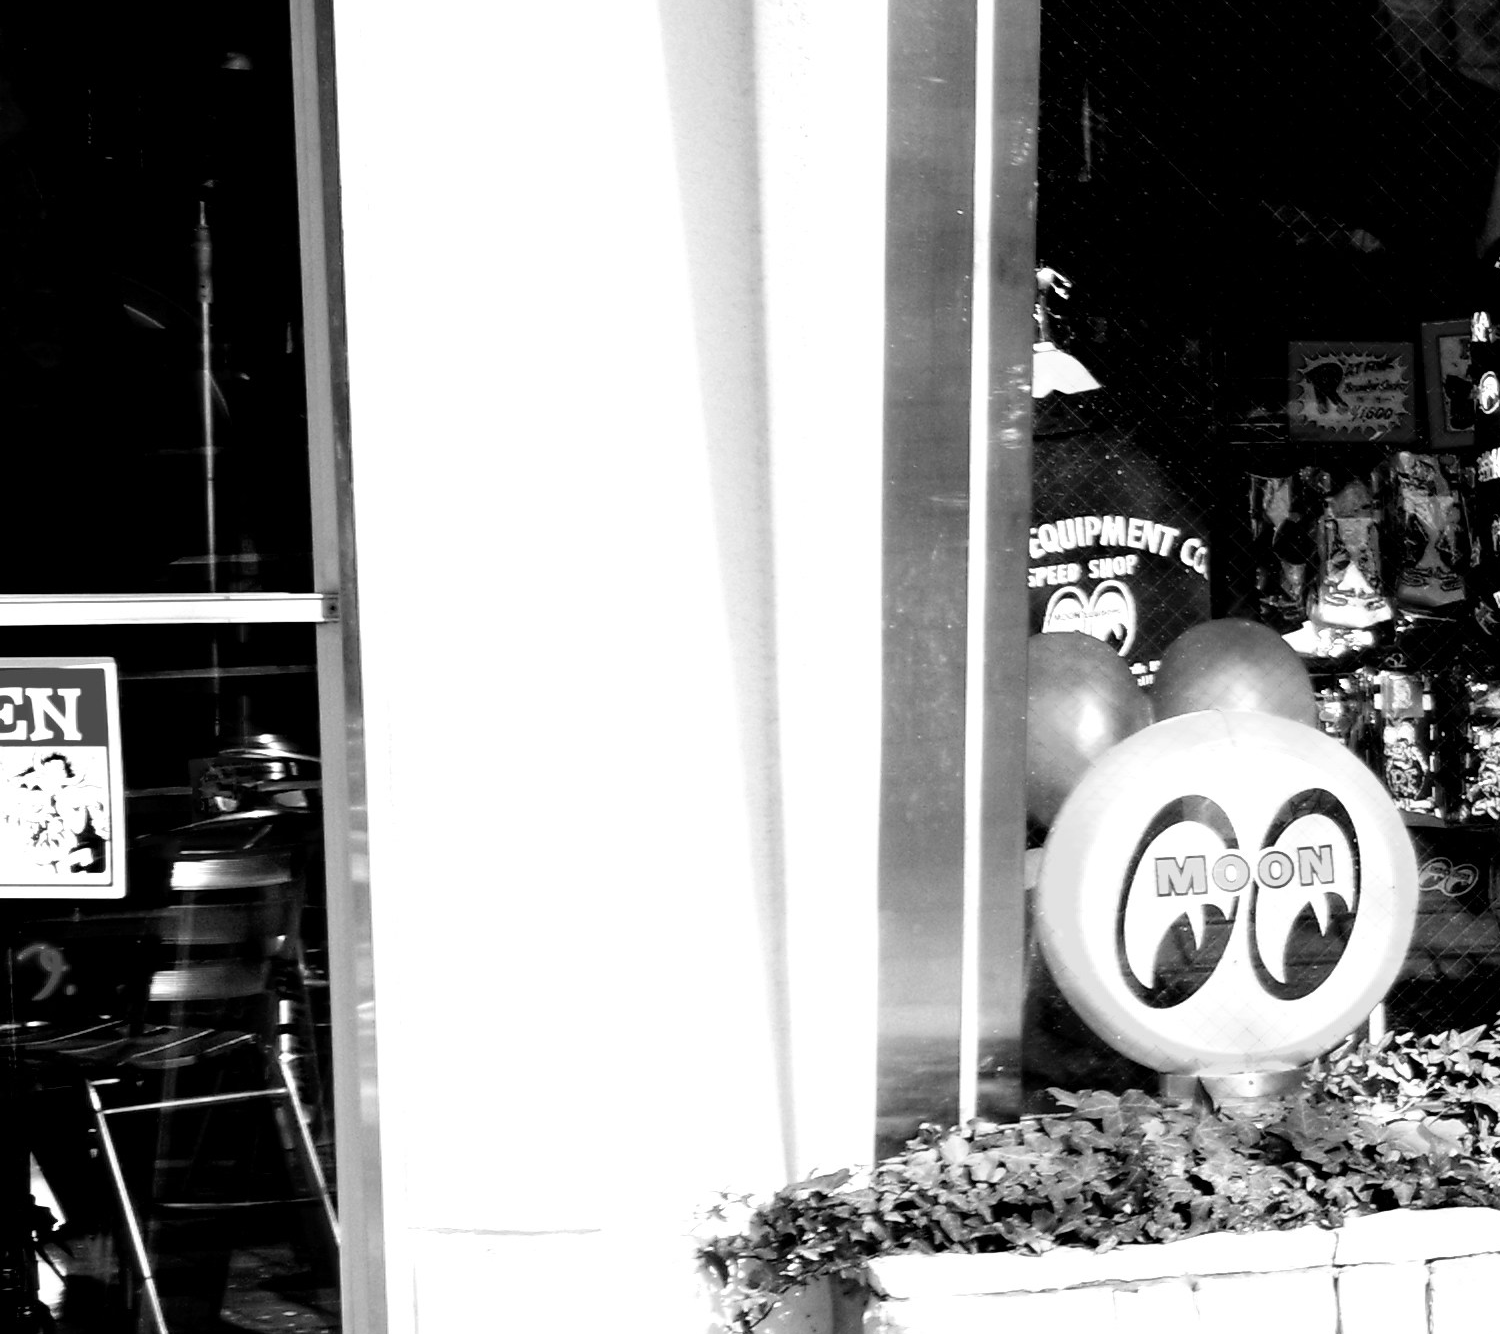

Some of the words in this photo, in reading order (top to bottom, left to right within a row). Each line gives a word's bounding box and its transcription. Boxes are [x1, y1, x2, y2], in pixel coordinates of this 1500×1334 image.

[1028, 514, 1181, 560] EQUIPMENT
[1028, 563, 1082, 588] SPEED
[1088, 554, 1140, 579] SHOP
[1154, 844, 1335, 898] MOON
